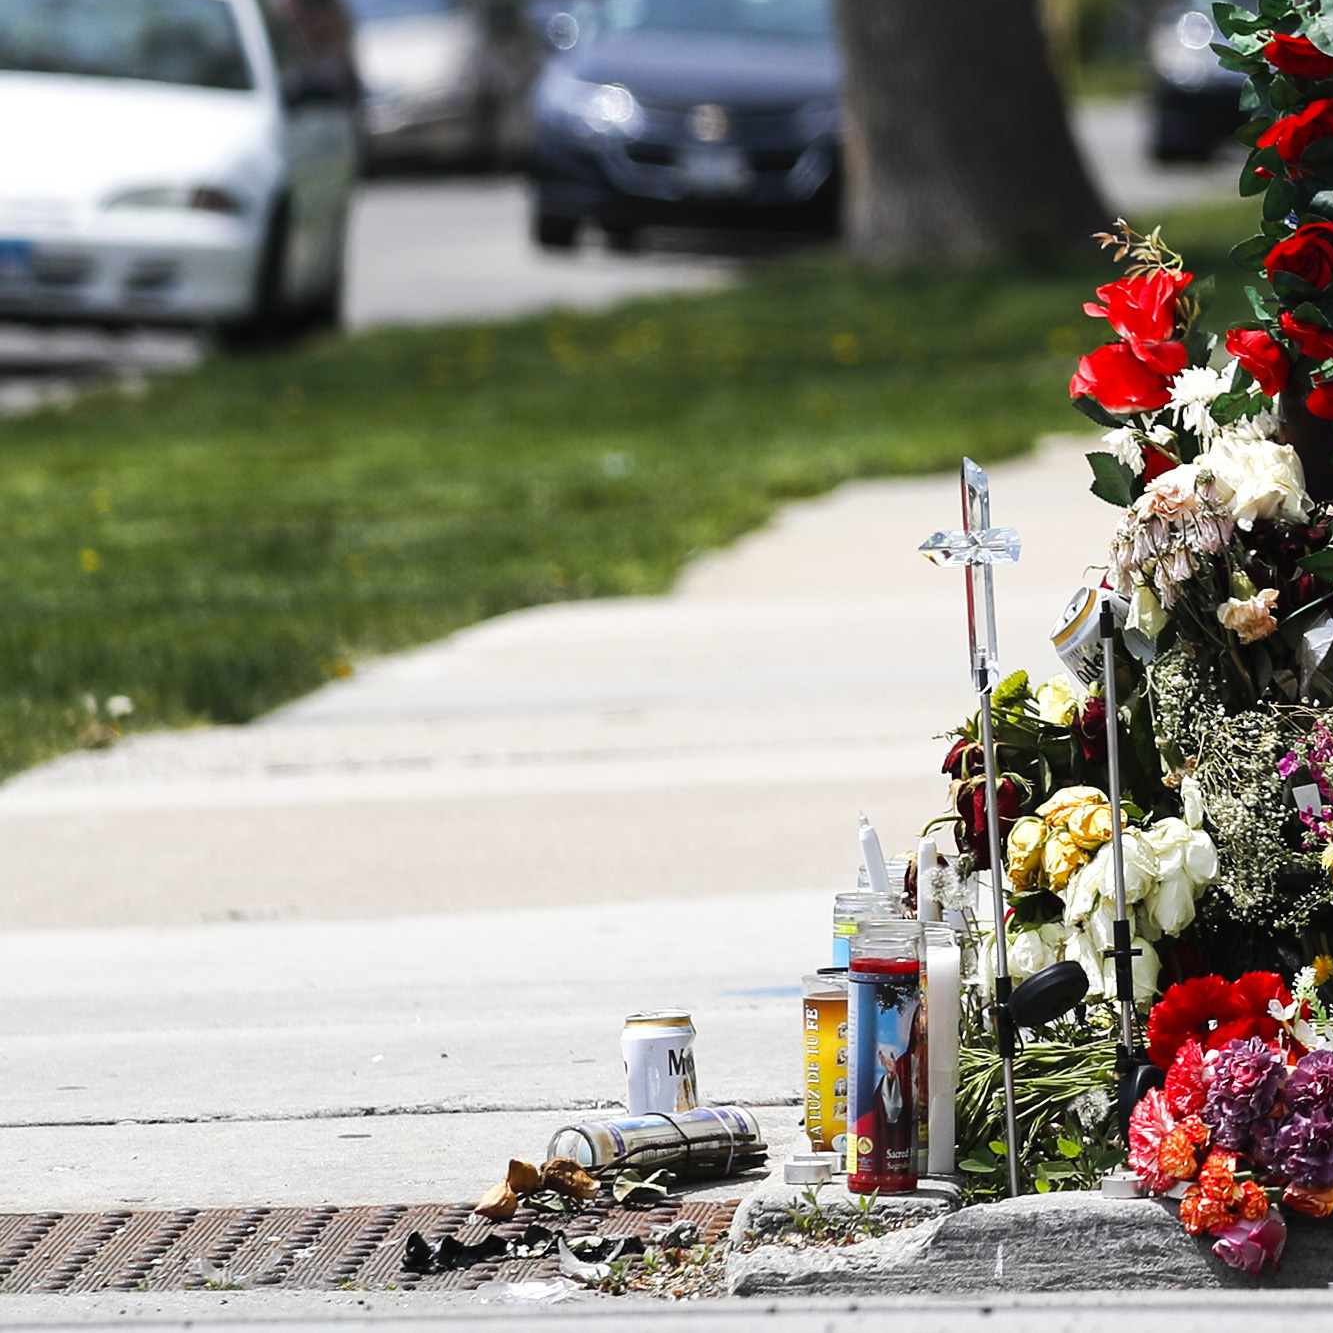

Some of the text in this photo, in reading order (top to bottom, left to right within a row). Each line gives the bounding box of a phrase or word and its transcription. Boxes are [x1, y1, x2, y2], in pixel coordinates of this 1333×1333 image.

[805, 1008, 819, 1031] FE
[807, 1061, 821, 1084] DE
[807, 1089, 822, 1121] LUZ
[886, 1148, 909, 1160] Sacred
